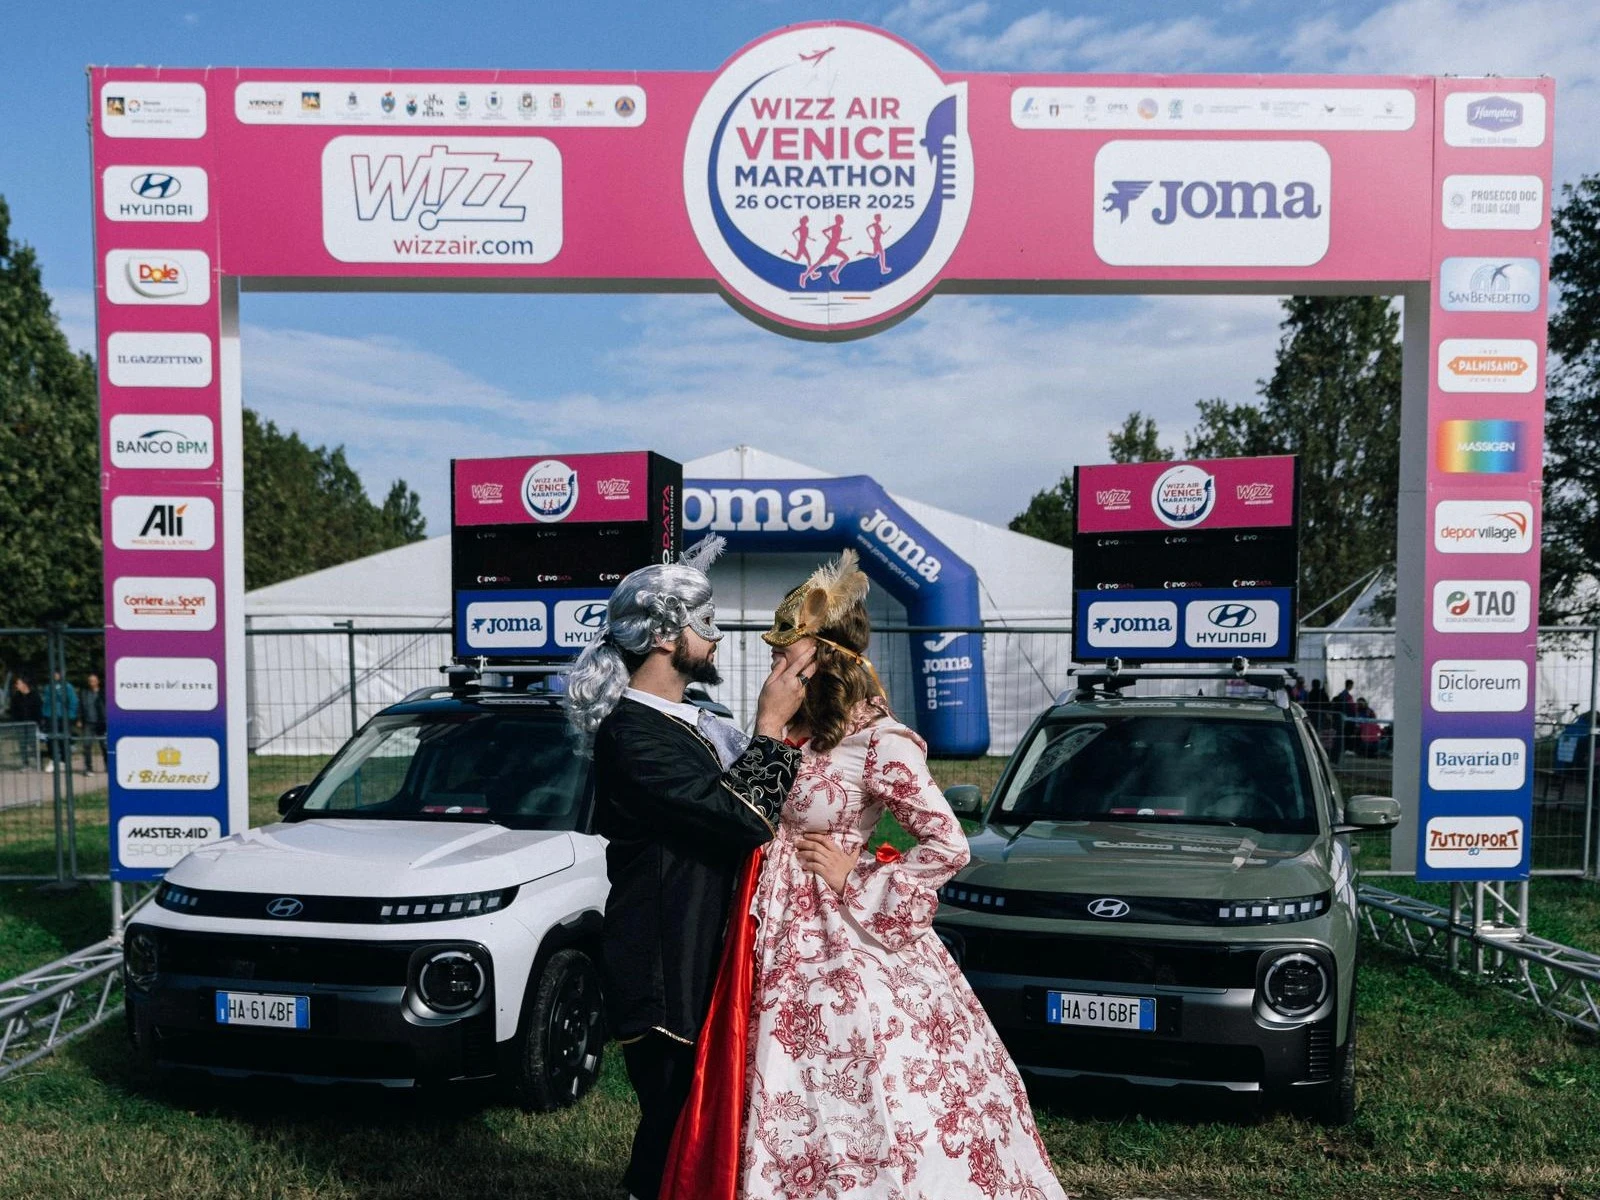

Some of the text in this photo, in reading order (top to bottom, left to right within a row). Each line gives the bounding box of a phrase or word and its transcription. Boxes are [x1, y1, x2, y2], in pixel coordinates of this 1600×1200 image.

[750, 97, 900, 120] WIZZ AIR
[1472, 105, 1517, 121] Hampton
[735, 126, 915, 161] VENICE
[734, 165, 916, 187] MARATHON
[734, 195, 915, 210] 26 OCTOBER 2025
[1471, 190, 1538, 202] PROSECCO DOC
[120, 204, 193, 216] HYUNDAI
[393, 235, 534, 255] wizzair.com
[139, 264, 179, 281] Dole
[117, 355, 204, 365] IL GAZZETTINO
[1458, 360, 1518, 372] PALMISANO
[116, 440, 208, 454] BANCO BPM
[1456, 441, 1516, 452] MASSIGEN
[531, 483, 567, 491] VENICE
[1163, 488, 1202, 497] VENICE
[682, 488, 835, 531] oma
[124, 595, 164, 606] Corriere
[1474, 590, 1516, 616] TAO
[1196, 632, 1267, 643] HYUNDAI
[119, 682, 151, 690] PORTE
[1438, 673, 1521, 690] Dicloreum
[1438, 692, 1454, 702] ICE
[1435, 751, 1500, 766] Bavaria
[127, 769, 211, 784] i Bibanesi
